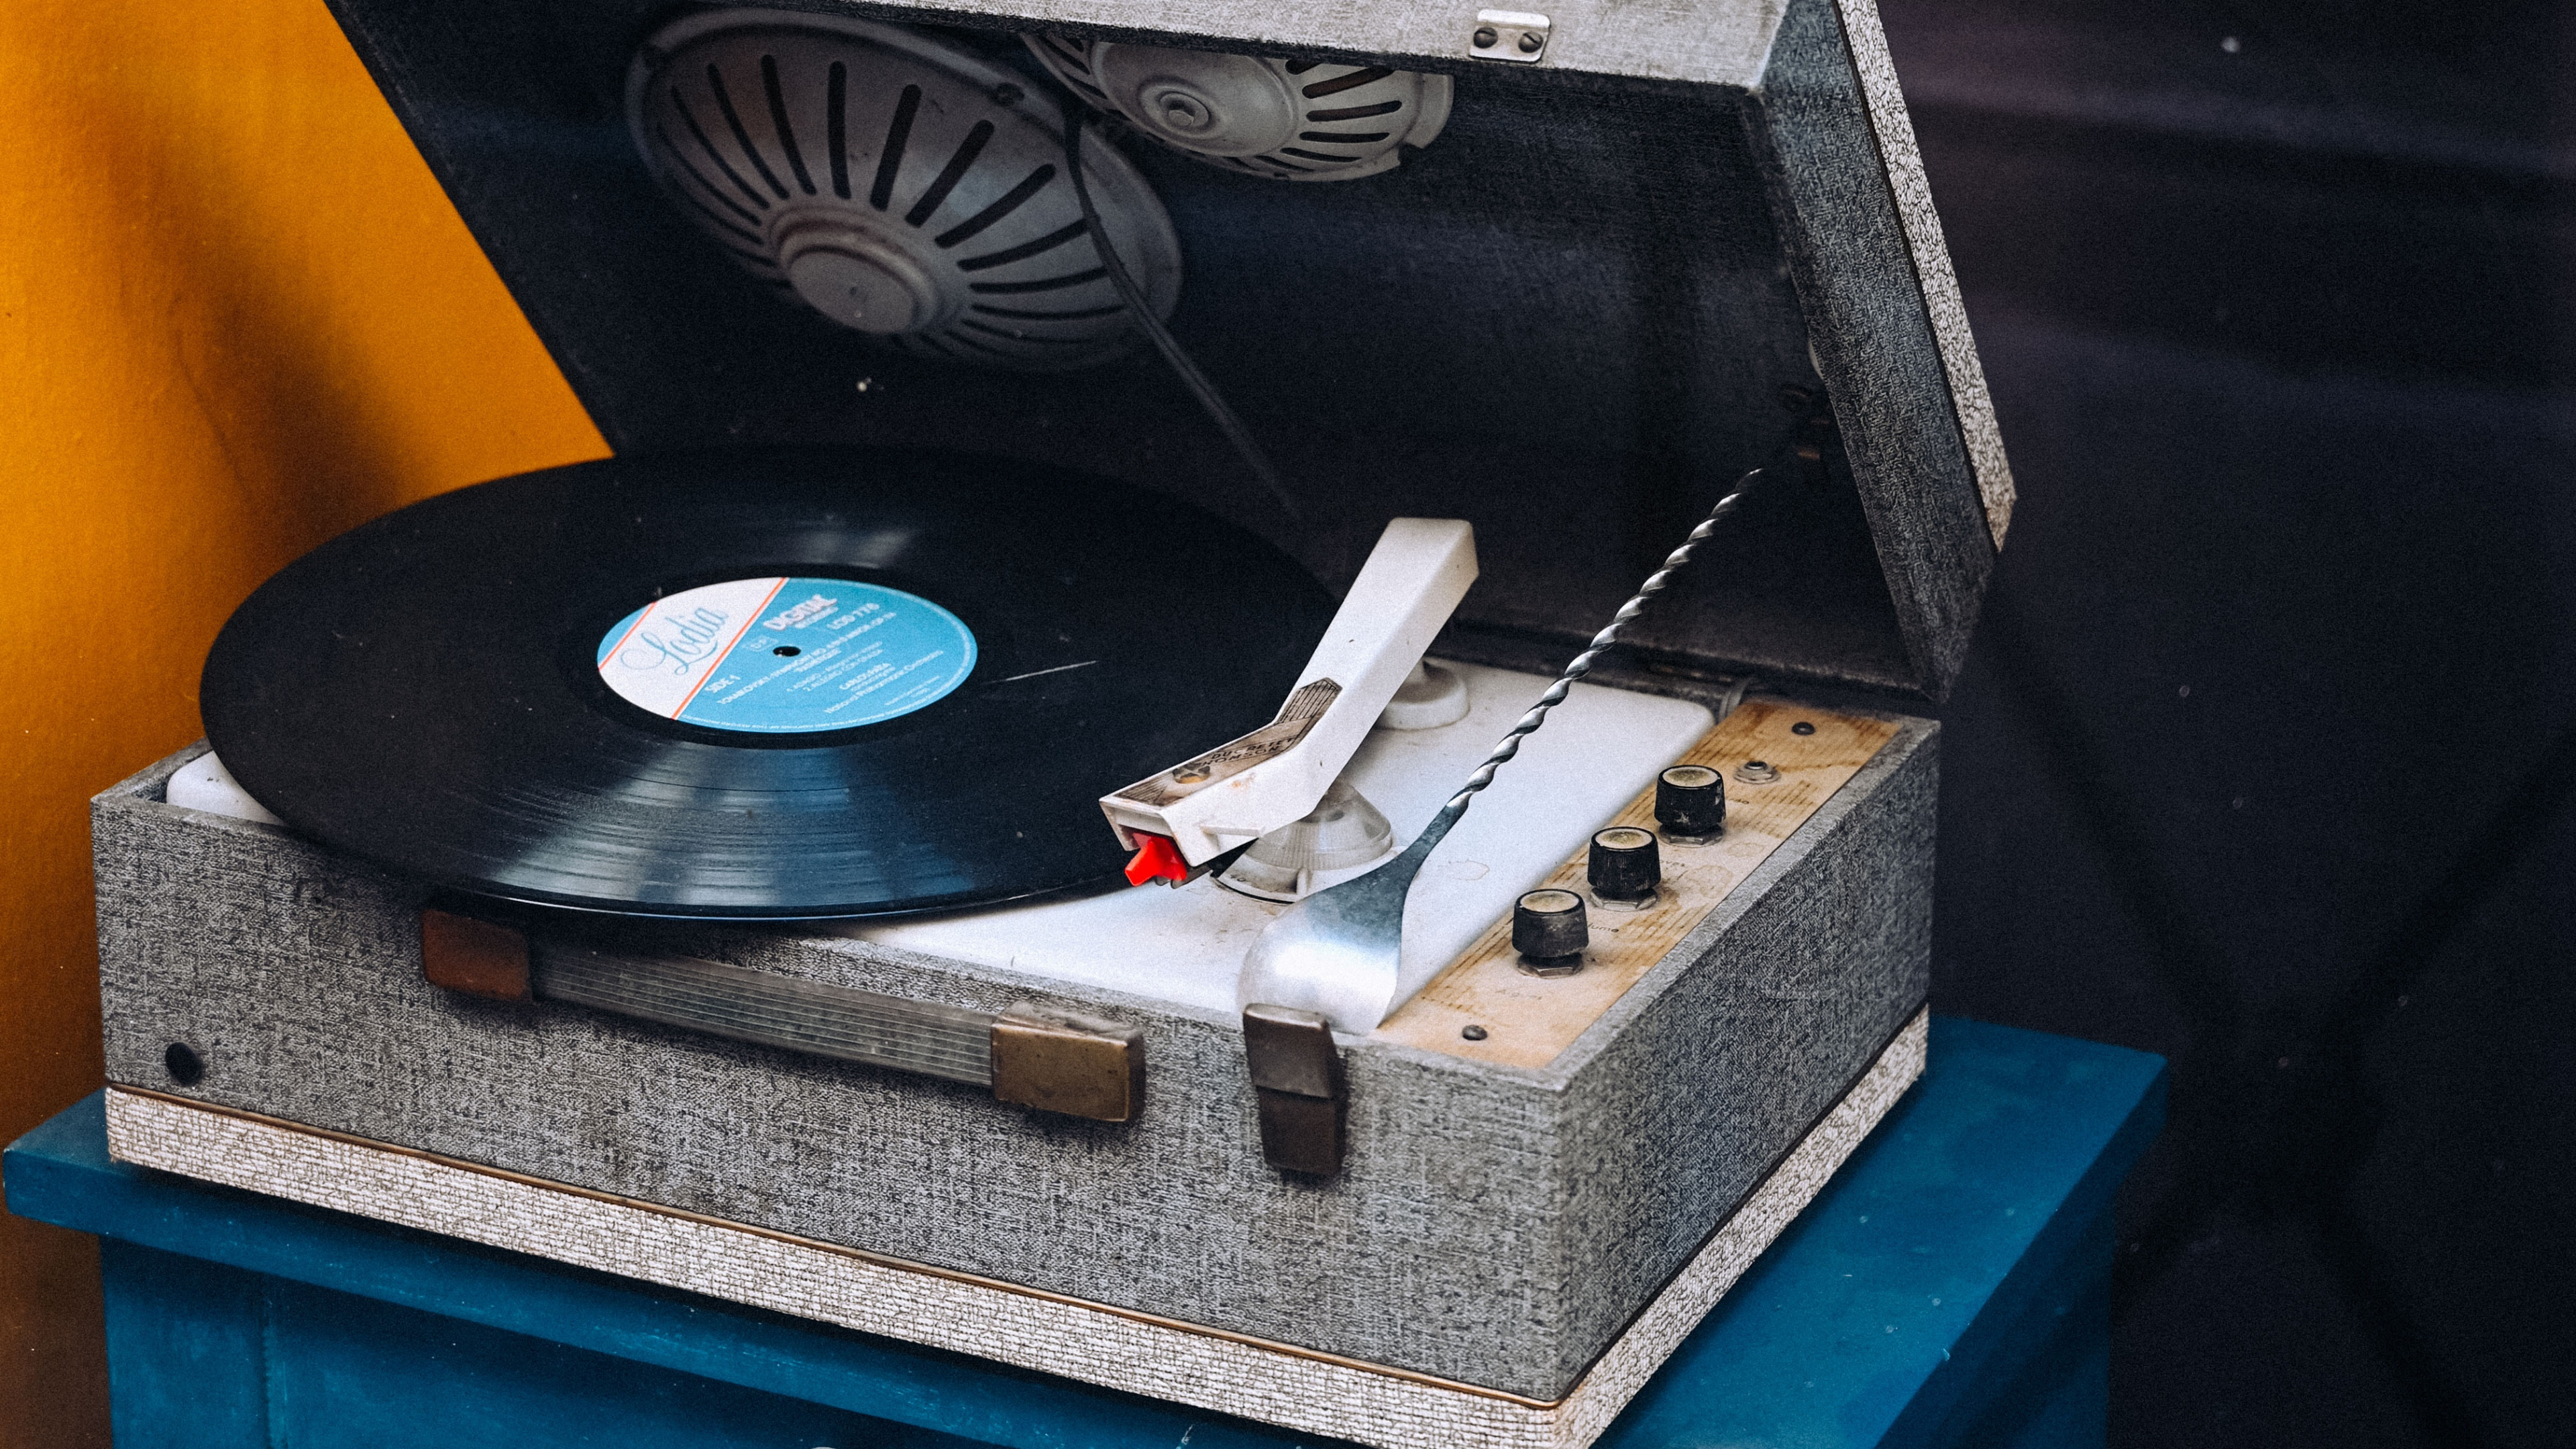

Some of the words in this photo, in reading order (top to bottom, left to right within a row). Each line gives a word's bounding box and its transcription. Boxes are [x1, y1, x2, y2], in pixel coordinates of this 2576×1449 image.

[763, 594, 838, 631] DIGITAL
[621, 607, 729, 676] Lodia
[706, 678, 735, 693] SIDE
[1201, 745, 1280, 766] HOMSON
